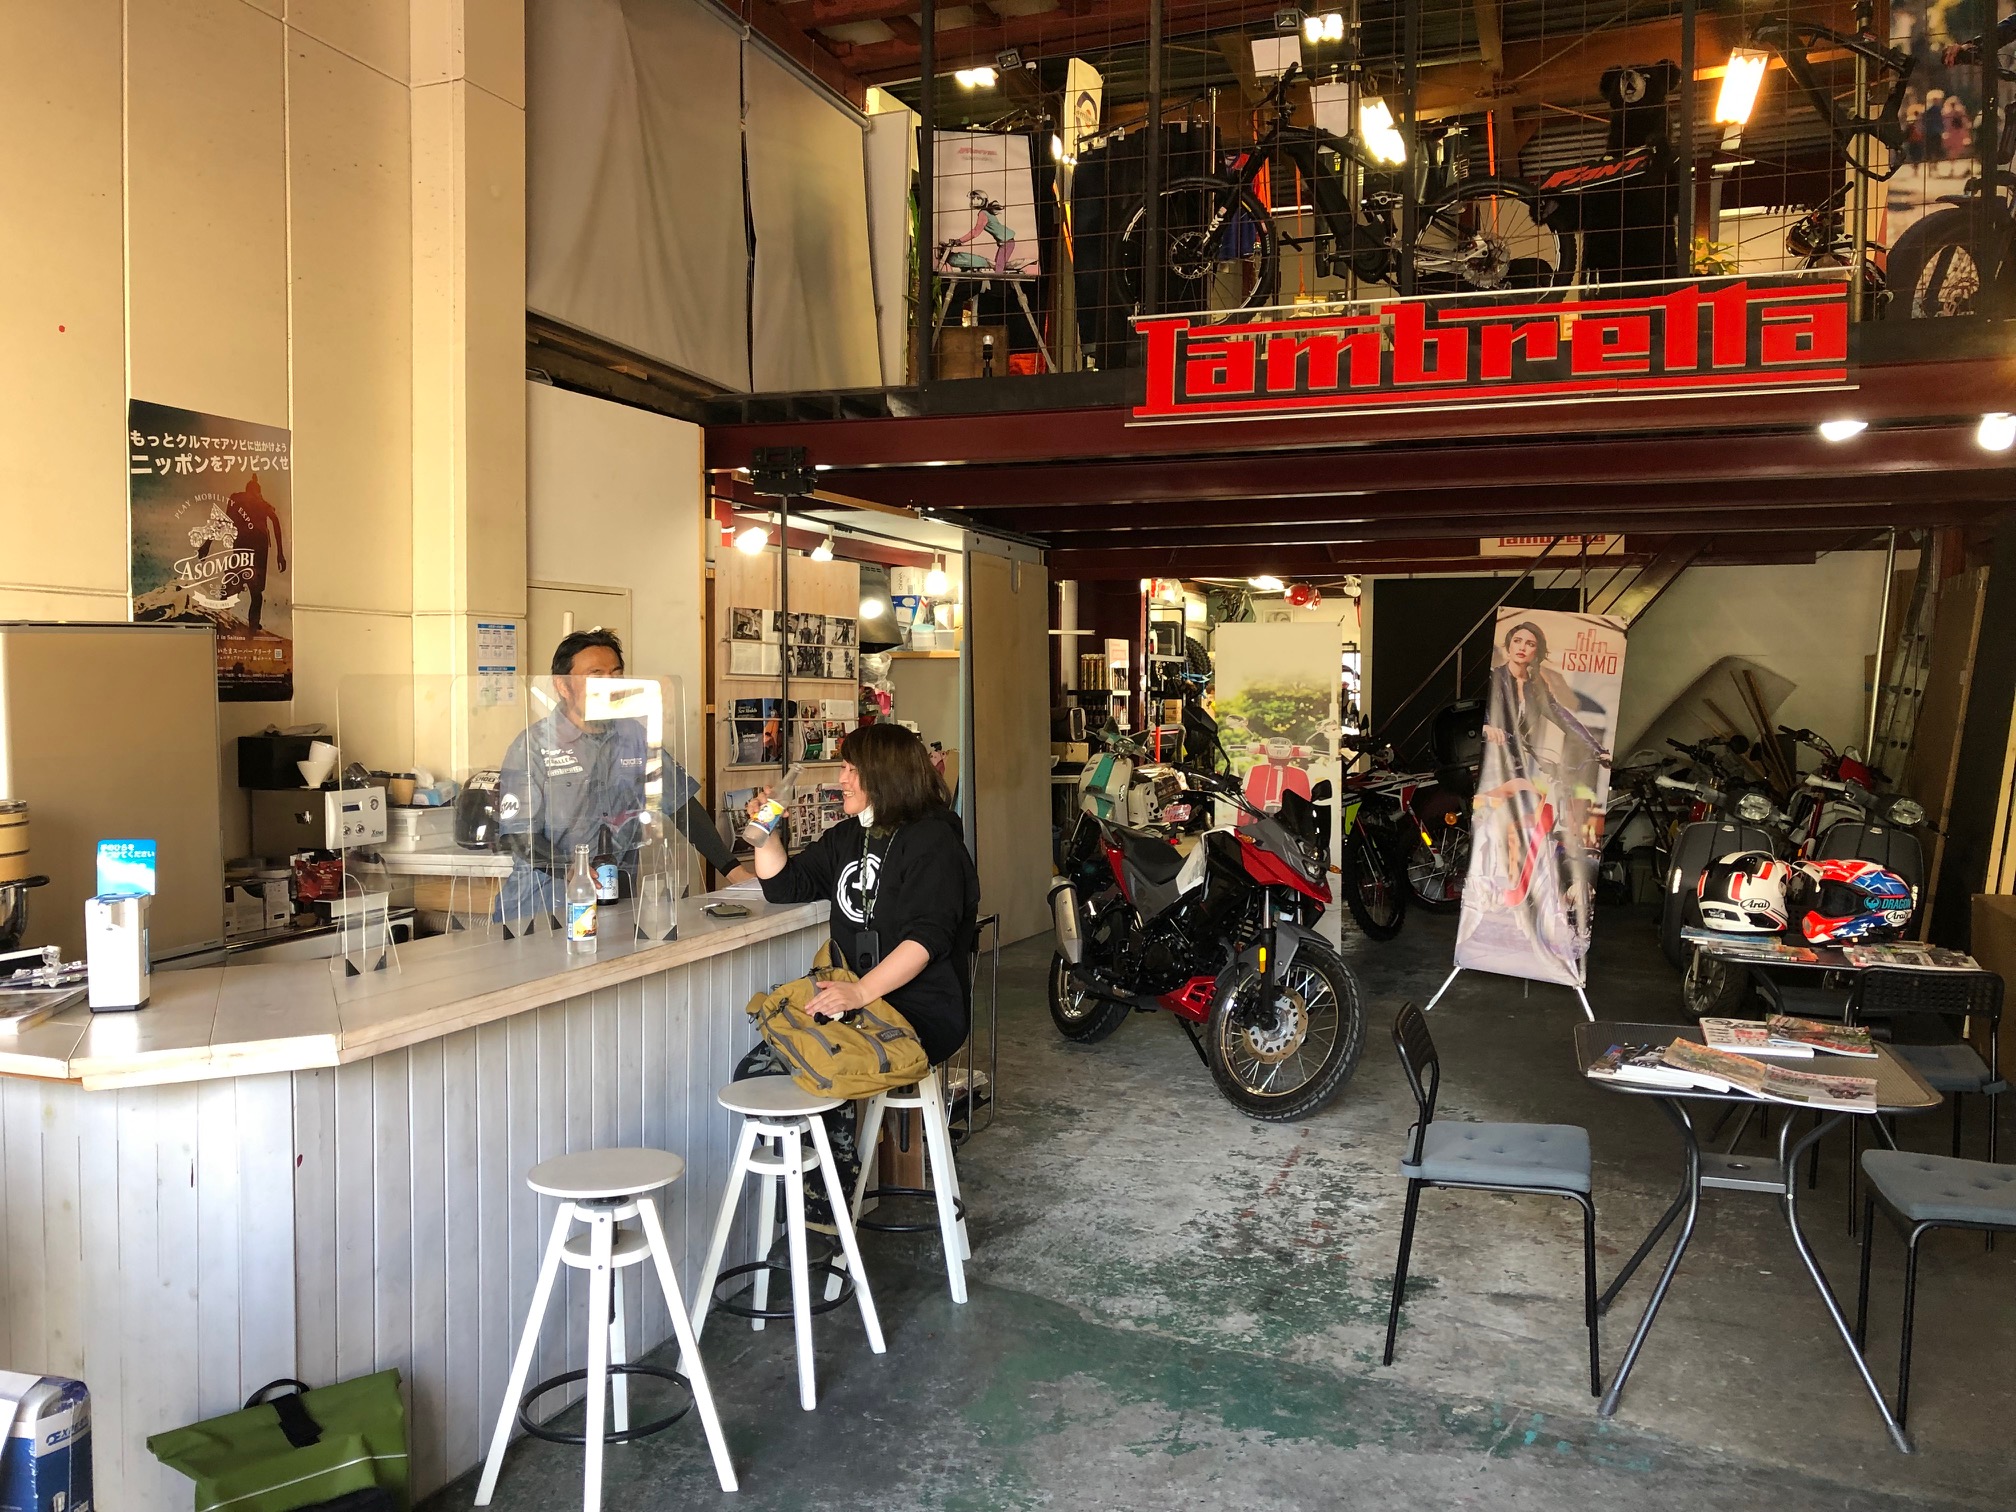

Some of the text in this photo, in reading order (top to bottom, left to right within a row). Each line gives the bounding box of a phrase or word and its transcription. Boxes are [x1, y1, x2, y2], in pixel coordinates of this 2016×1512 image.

[1133, 280, 1847, 417] Lambretta
[130, 430, 287, 453] もっとクルマでアソビに出かけよう
[130, 453, 289, 476] ニッポンをアソビつくせ
[174, 493, 254, 530] PLAY MOBILITY EXPO
[180, 553, 255, 581] ASOMOBI
[1562, 652, 1617, 674] ISSIMO
[1742, 899, 1767, 909] Arai
[1881, 898, 1912, 910] DRAGON
[1887, 910, 1906, 920] Arai
